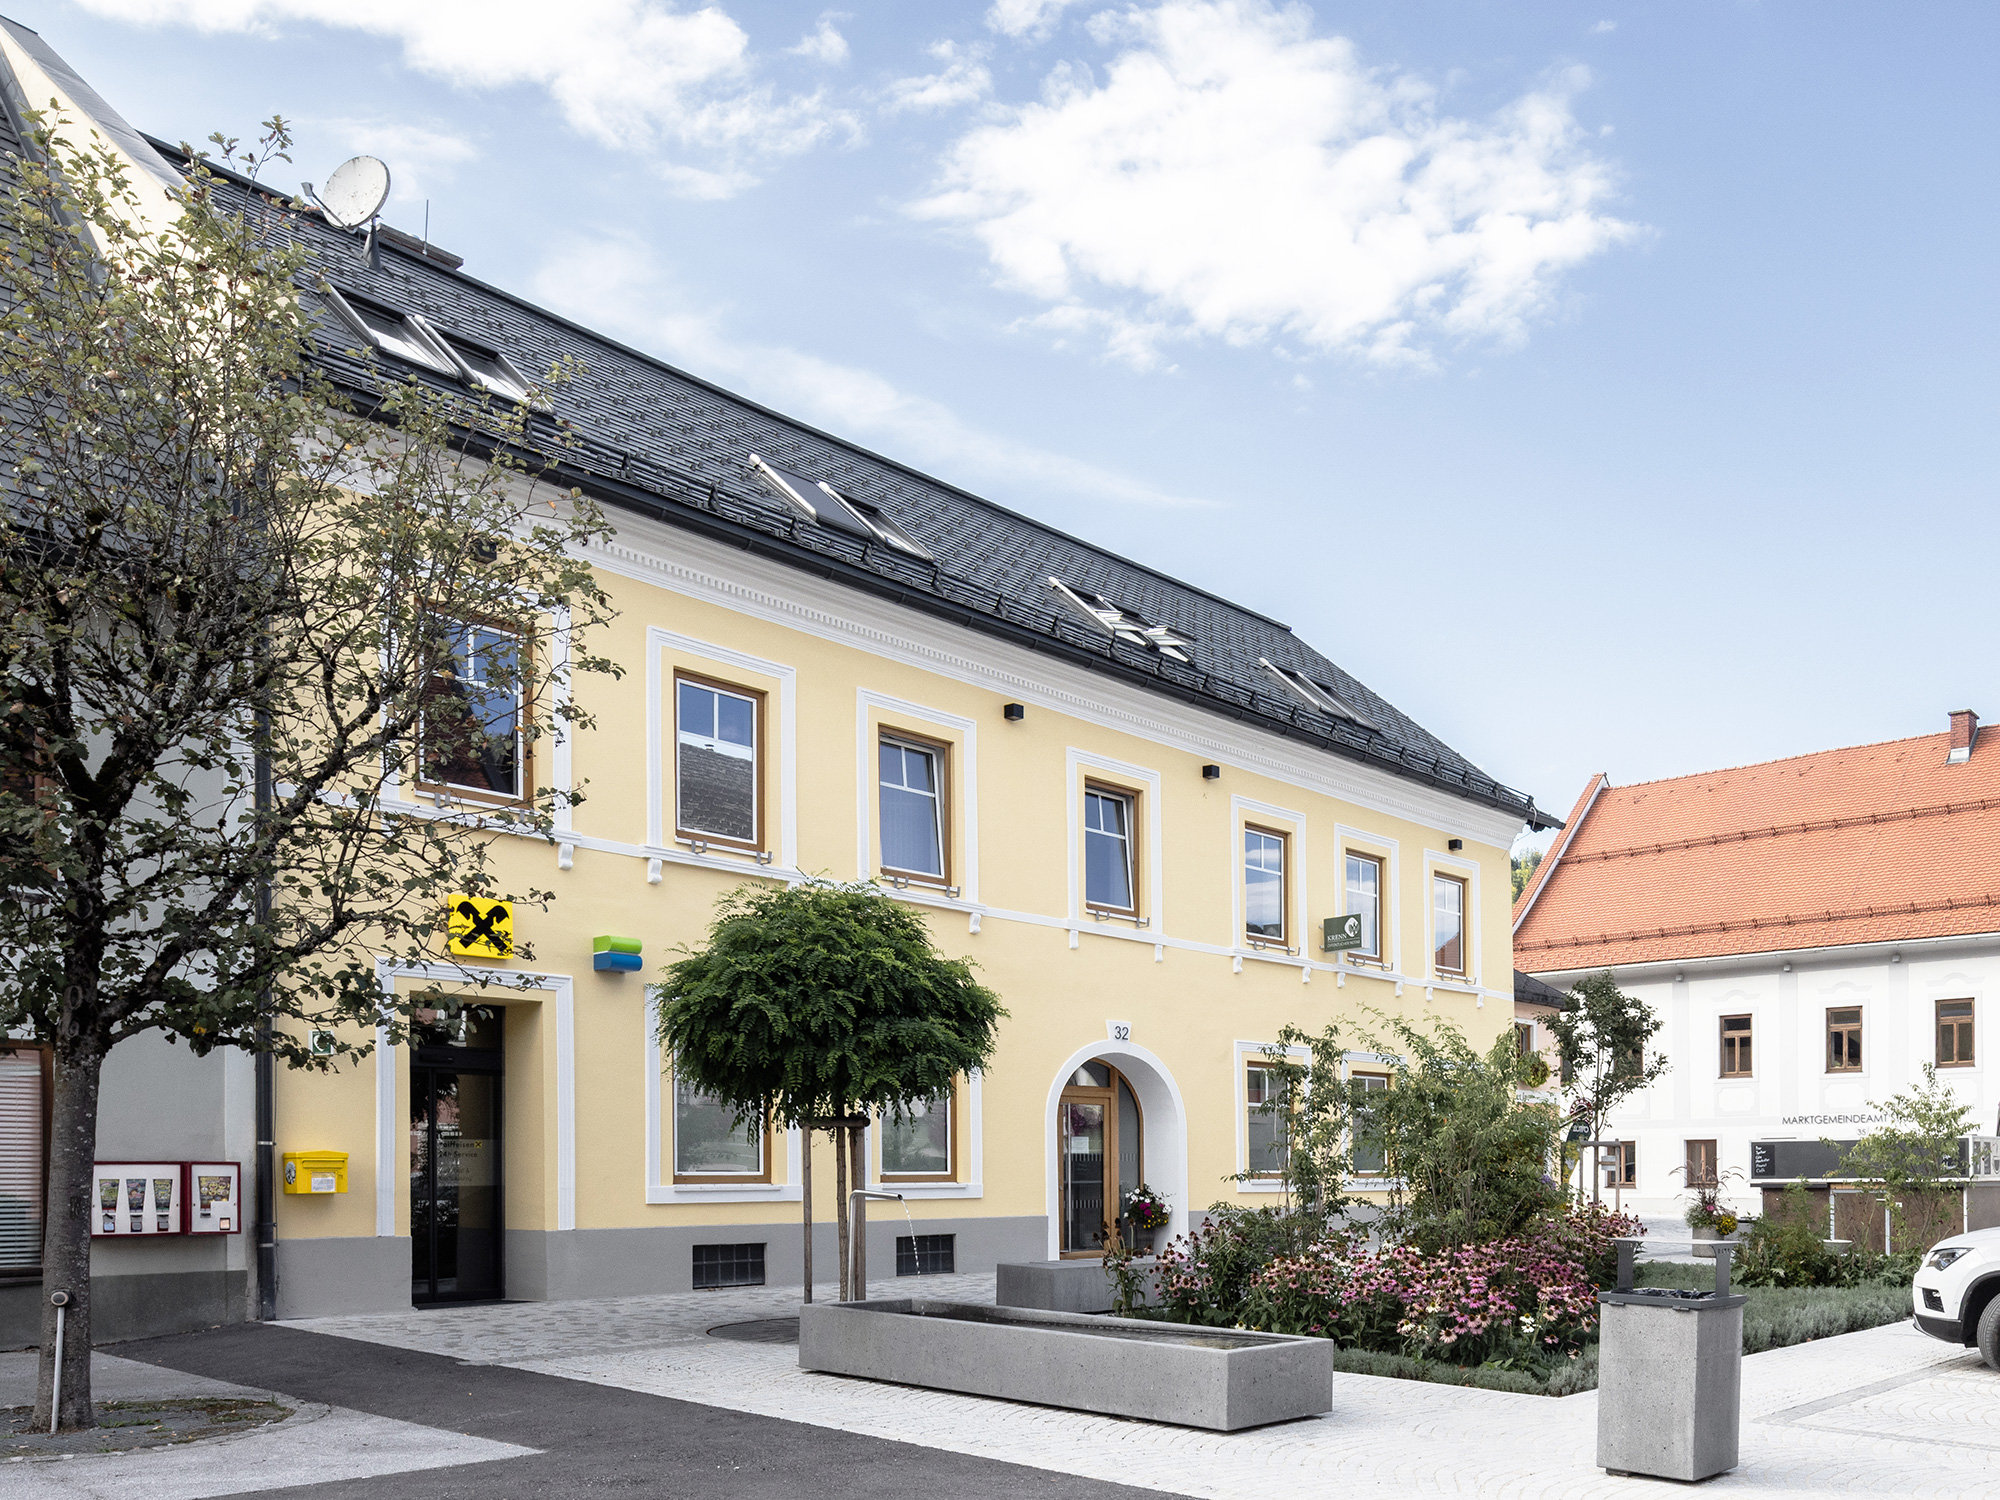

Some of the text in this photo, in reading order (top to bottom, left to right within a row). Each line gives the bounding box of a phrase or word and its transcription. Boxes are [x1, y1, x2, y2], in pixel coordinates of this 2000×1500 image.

[1327, 933, 1348, 941] KRENN
[1115, 1025, 1129, 1040] 32
[1782, 1114, 1888, 1125] MARKTGEMEINDEAMT
[453, 1150, 478, 1158] Service
